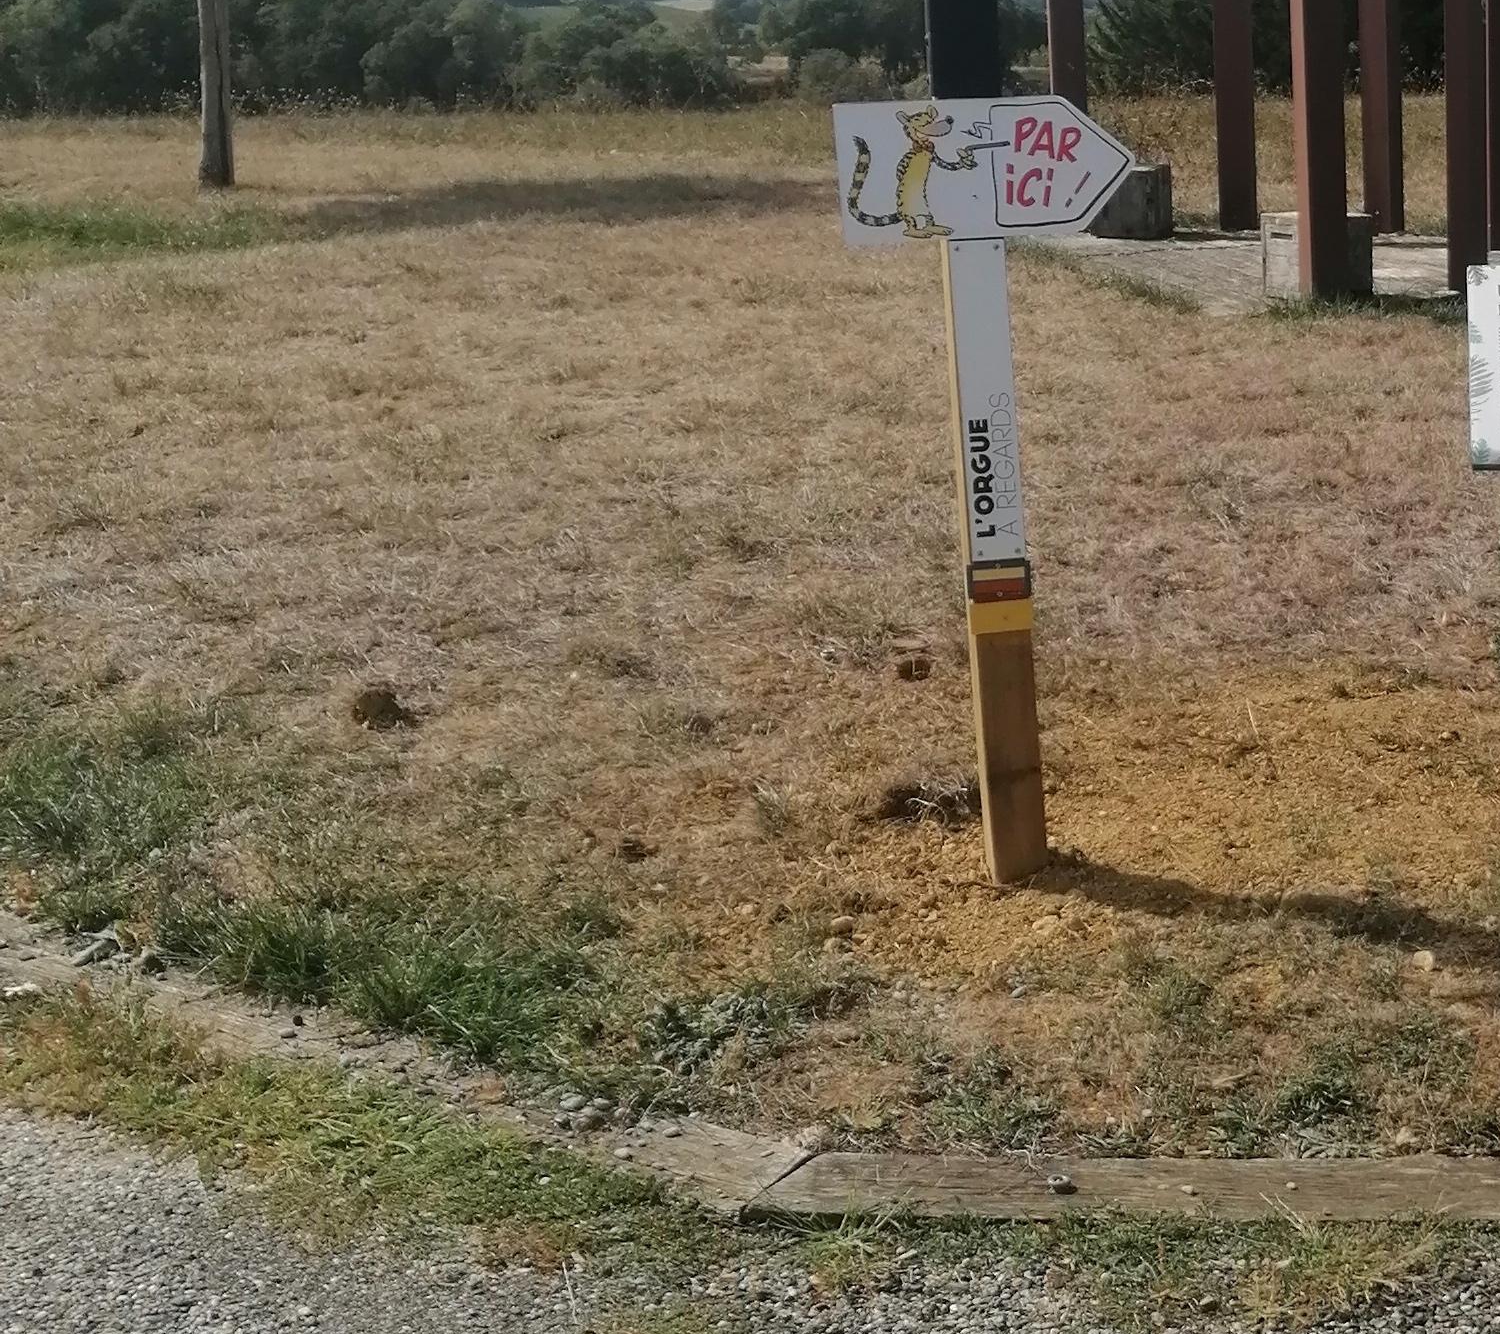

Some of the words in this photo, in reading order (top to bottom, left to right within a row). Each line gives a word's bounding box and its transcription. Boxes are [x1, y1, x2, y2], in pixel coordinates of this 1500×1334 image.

[1014, 116, 1082, 163] PAR
[968, 419, 996, 538] L'ORGUE
[989, 392, 1017, 509] REGARDS
